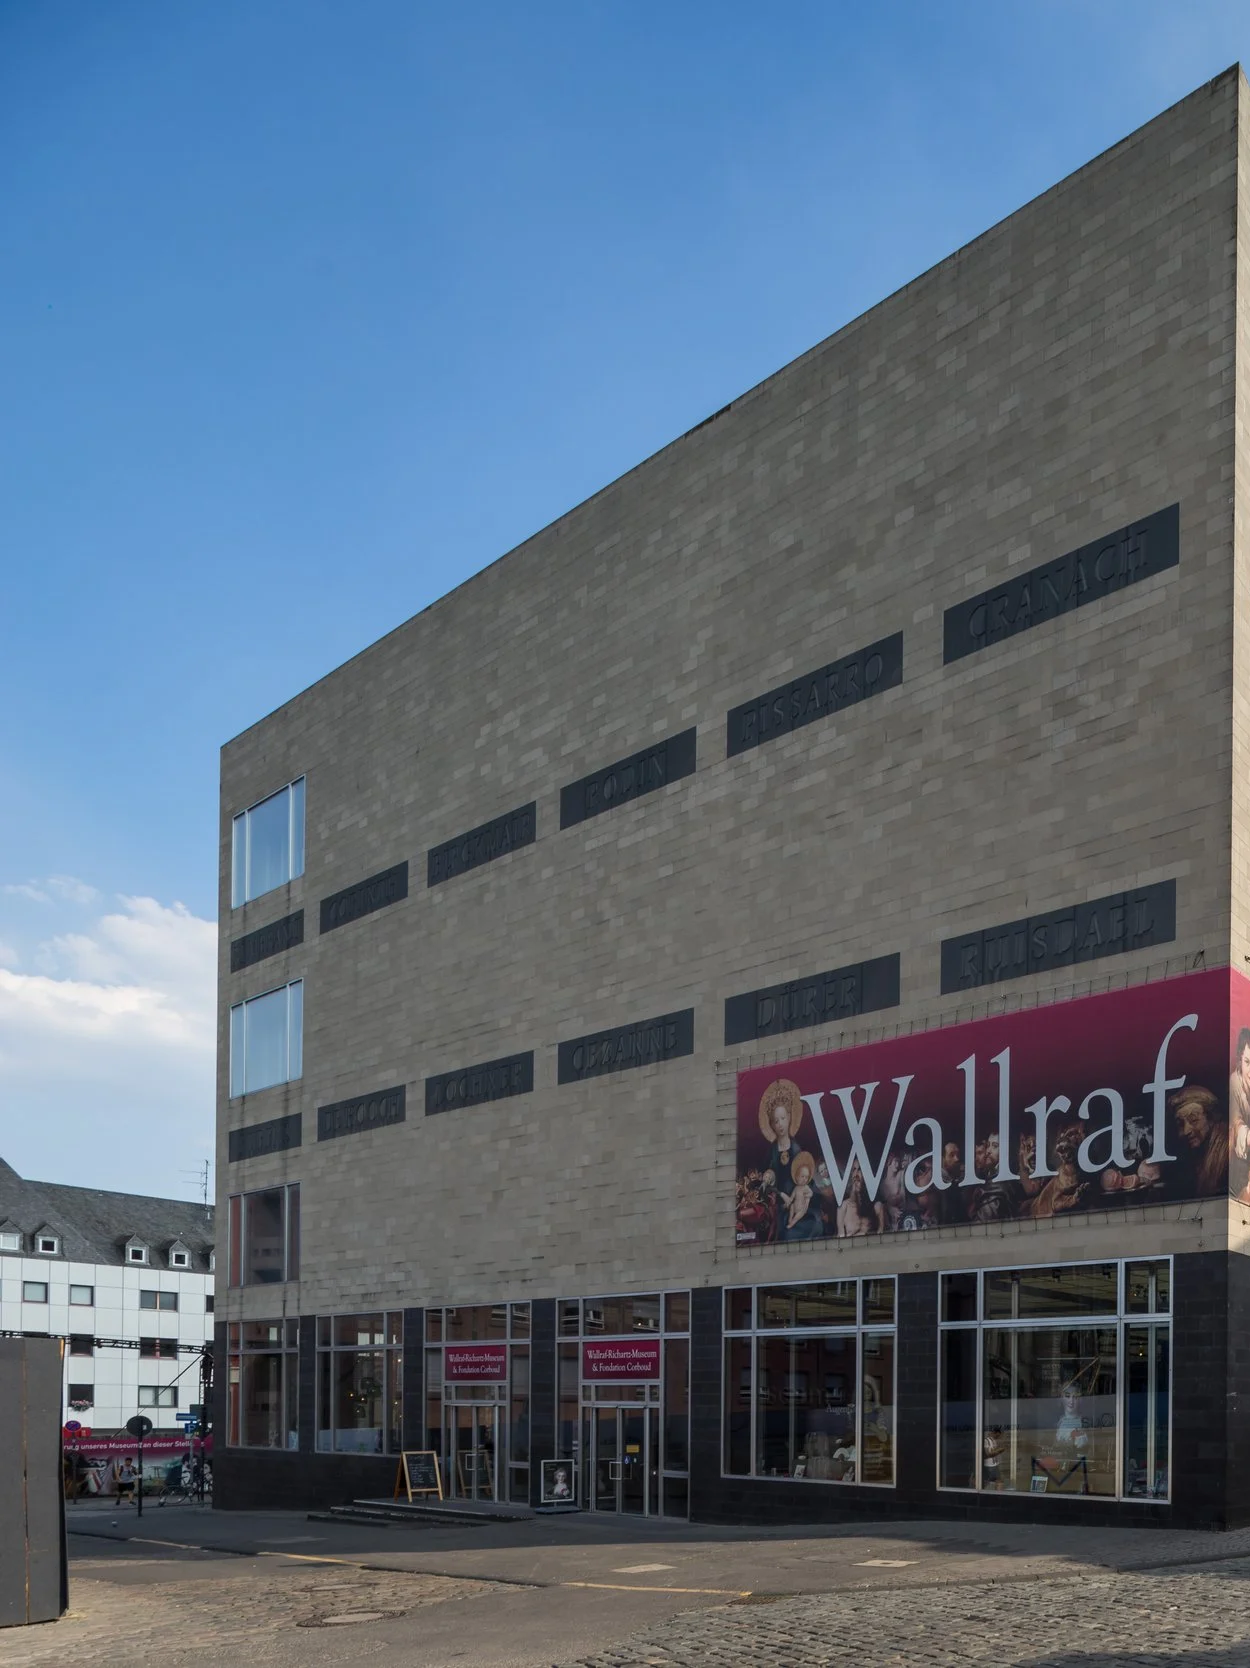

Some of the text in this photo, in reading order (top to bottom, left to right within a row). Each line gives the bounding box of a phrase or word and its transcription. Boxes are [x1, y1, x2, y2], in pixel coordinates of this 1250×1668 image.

[968, 529, 1149, 640] CRANACH
[740, 651, 883, 743] PISSARRO
[585, 748, 668, 810] RODIN
[959, 898, 1155, 979] RUISDAEL
[756, 974, 860, 1029] DÜRER
[800, 1013, 1199, 1207] Wallraf
[587, 1348, 657, 1360] Wallraf-Richartz-Museum
[592, 1361, 652, 1372] & Fondation Corboud
[80, 1442, 107, 1450] unseres
[153, 1440, 173, 1448] dieser
